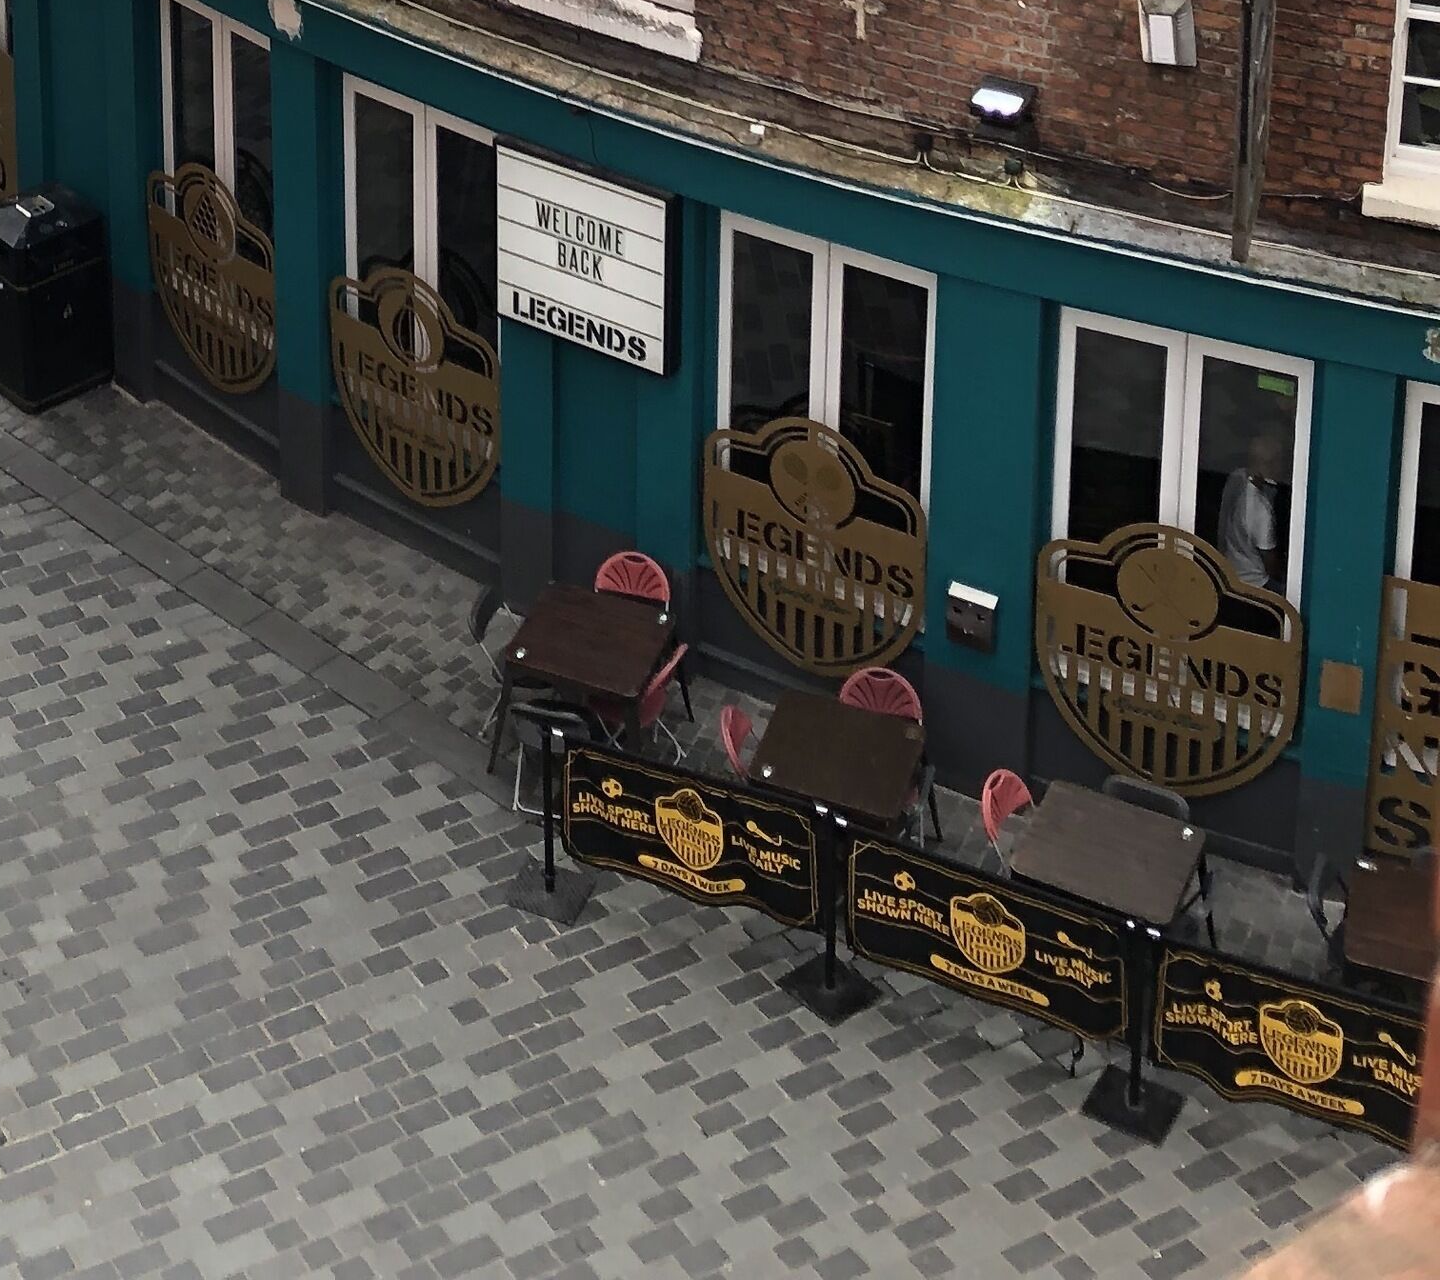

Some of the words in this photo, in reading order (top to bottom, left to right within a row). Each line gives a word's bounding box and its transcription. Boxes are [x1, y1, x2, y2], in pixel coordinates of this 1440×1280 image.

[535, 200, 624, 256] WELCOME
[558, 241, 603, 281] BACK
[155, 233, 274, 327] LEGENDS
[513, 290, 647, 362] LEGENDS
[339, 341, 494, 436] LEGENDS
[712, 500, 915, 599] LEGENDS
[1046, 615, 1283, 709] LEGENDS
[572, 802, 619, 827] SHOWN
[621, 817, 656, 834] HERE
[578, 792, 604, 810] LIVE
[607, 804, 650, 824] SPORT
[731, 835, 757, 857] LIVE
[759, 850, 801, 871] MUSIC
[748, 855, 784, 875] DAILY
[700, 880, 731, 892] WEEK
[858, 898, 911, 921] SHOWN
[914, 912, 950, 937] HERE
[864, 888, 896, 909] LIVE
[898, 896, 944, 922] SPORT
[953, 965, 982, 985] DAYS
[987, 977, 995, 988] A
[998, 981, 1034, 1001] WEEK
[1035, 949, 1068, 968] LIVE
[1071, 958, 1112, 984] MUSIC
[1055, 966, 1095, 989] DAILY
[1165, 1011, 1221, 1034] SHOWN
[1222, 1026, 1258, 1046] HERE
[1172, 1002, 1207, 1016] LIVE
[1209, 1007, 1252, 1034] SPORT
[1263, 1025, 1339, 1059] LEGENDS
[1353, 1055, 1389, 1072] LIVE
[1391, 1063, 1422, 1088] MUS
[1374, 1068, 1416, 1097] DAILY
[1250, 1073, 1257, 1084] 7
[1260, 1076, 1294, 1093] DAYS
[1297, 1086, 1306, 1099] A
[1309, 1090, 1346, 1111] WEEK
